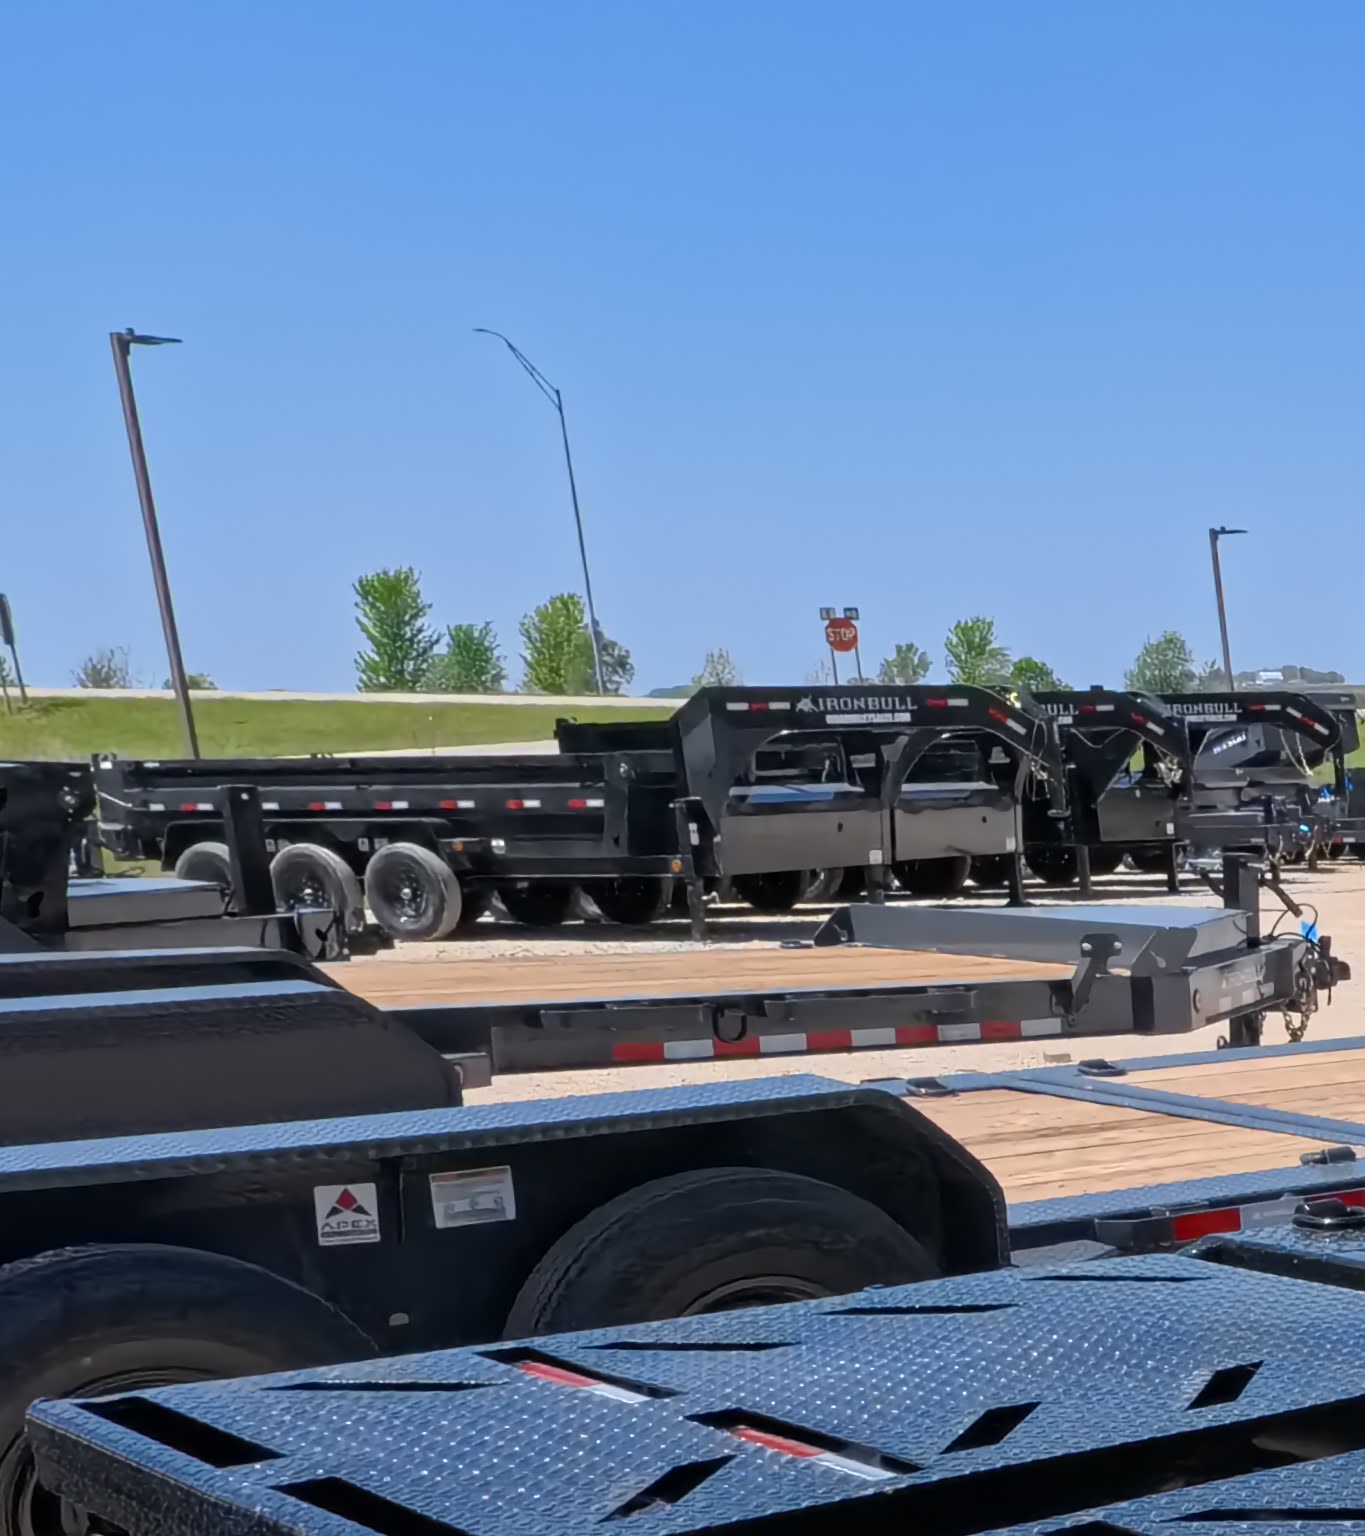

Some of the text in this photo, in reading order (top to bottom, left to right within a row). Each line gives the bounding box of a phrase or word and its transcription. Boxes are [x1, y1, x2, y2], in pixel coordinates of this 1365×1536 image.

[827, 627, 856, 641] STOP
[818, 696, 918, 711] IRONBULL
[321, 1219, 377, 1230] APEX
